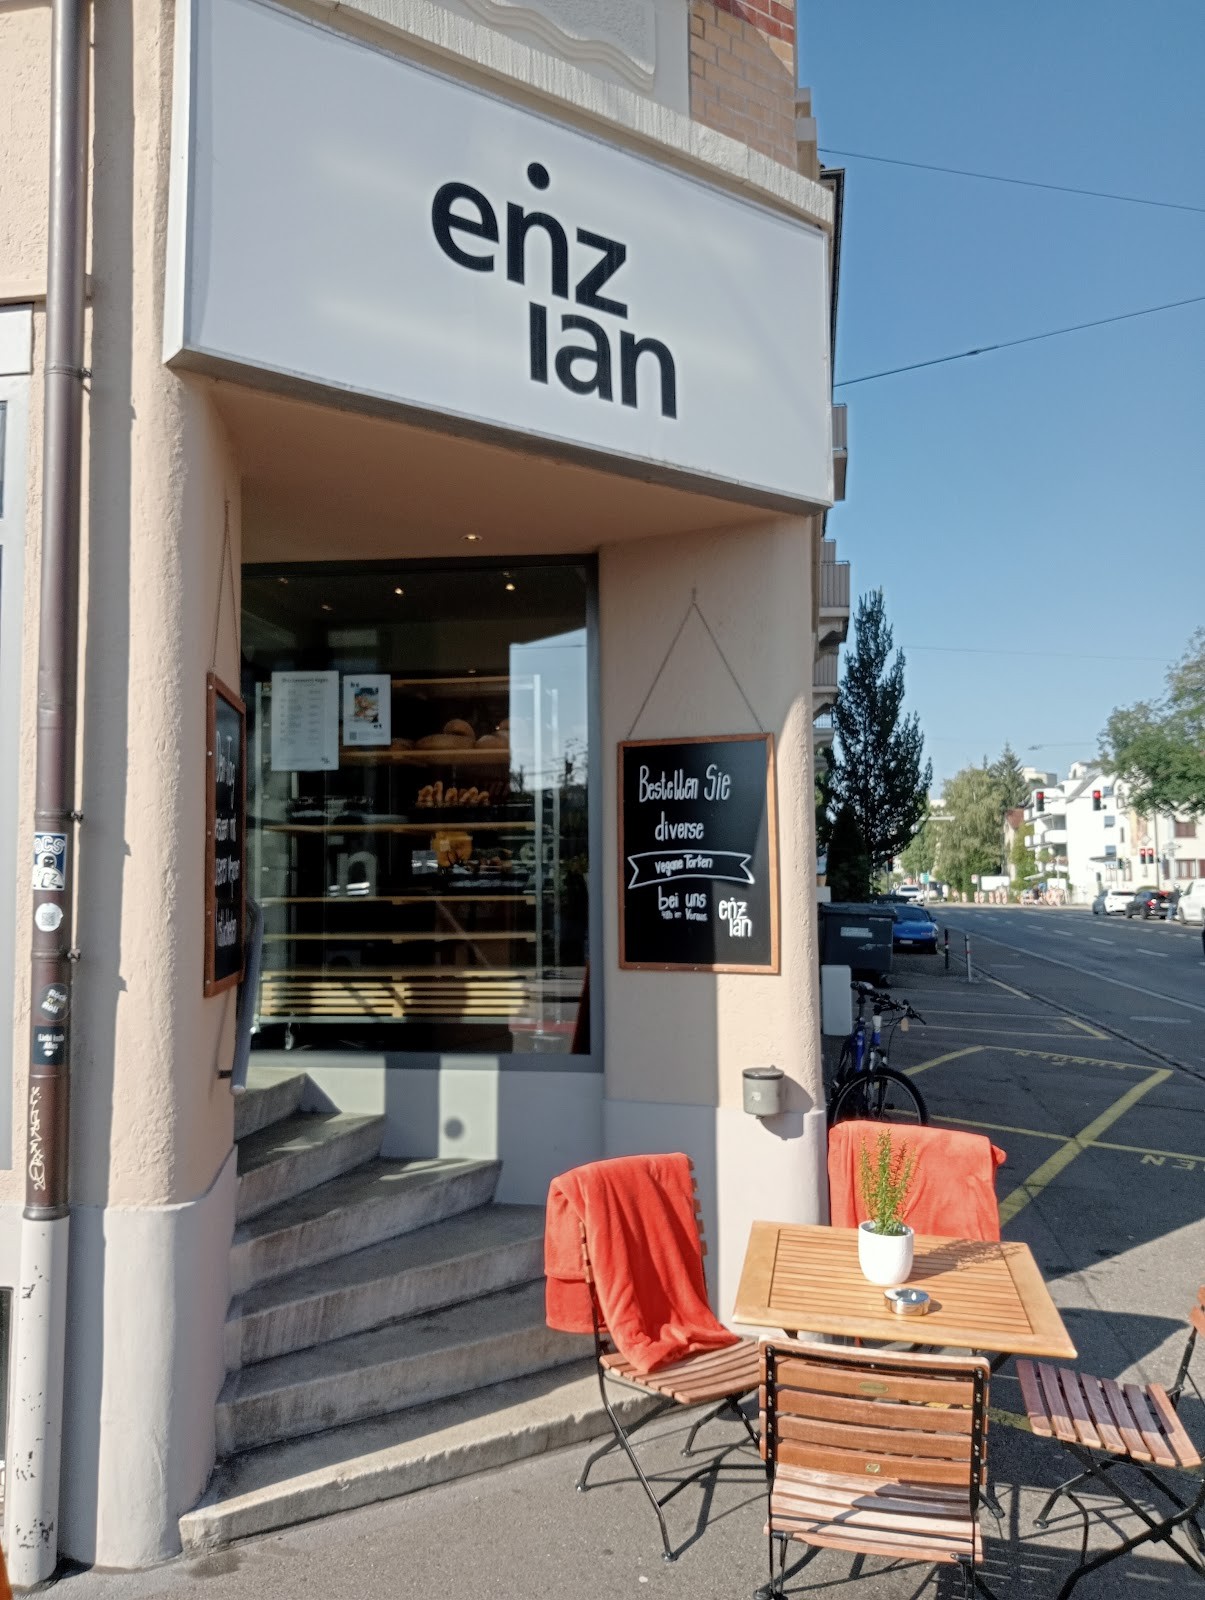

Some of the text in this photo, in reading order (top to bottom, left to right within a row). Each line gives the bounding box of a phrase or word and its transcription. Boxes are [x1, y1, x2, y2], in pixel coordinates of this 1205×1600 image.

[639, 763, 731, 803] Bestellen Sie
[655, 811, 704, 841] diverse
[683, 854, 713, 869] Torten
[658, 886, 706, 911] bei uns
